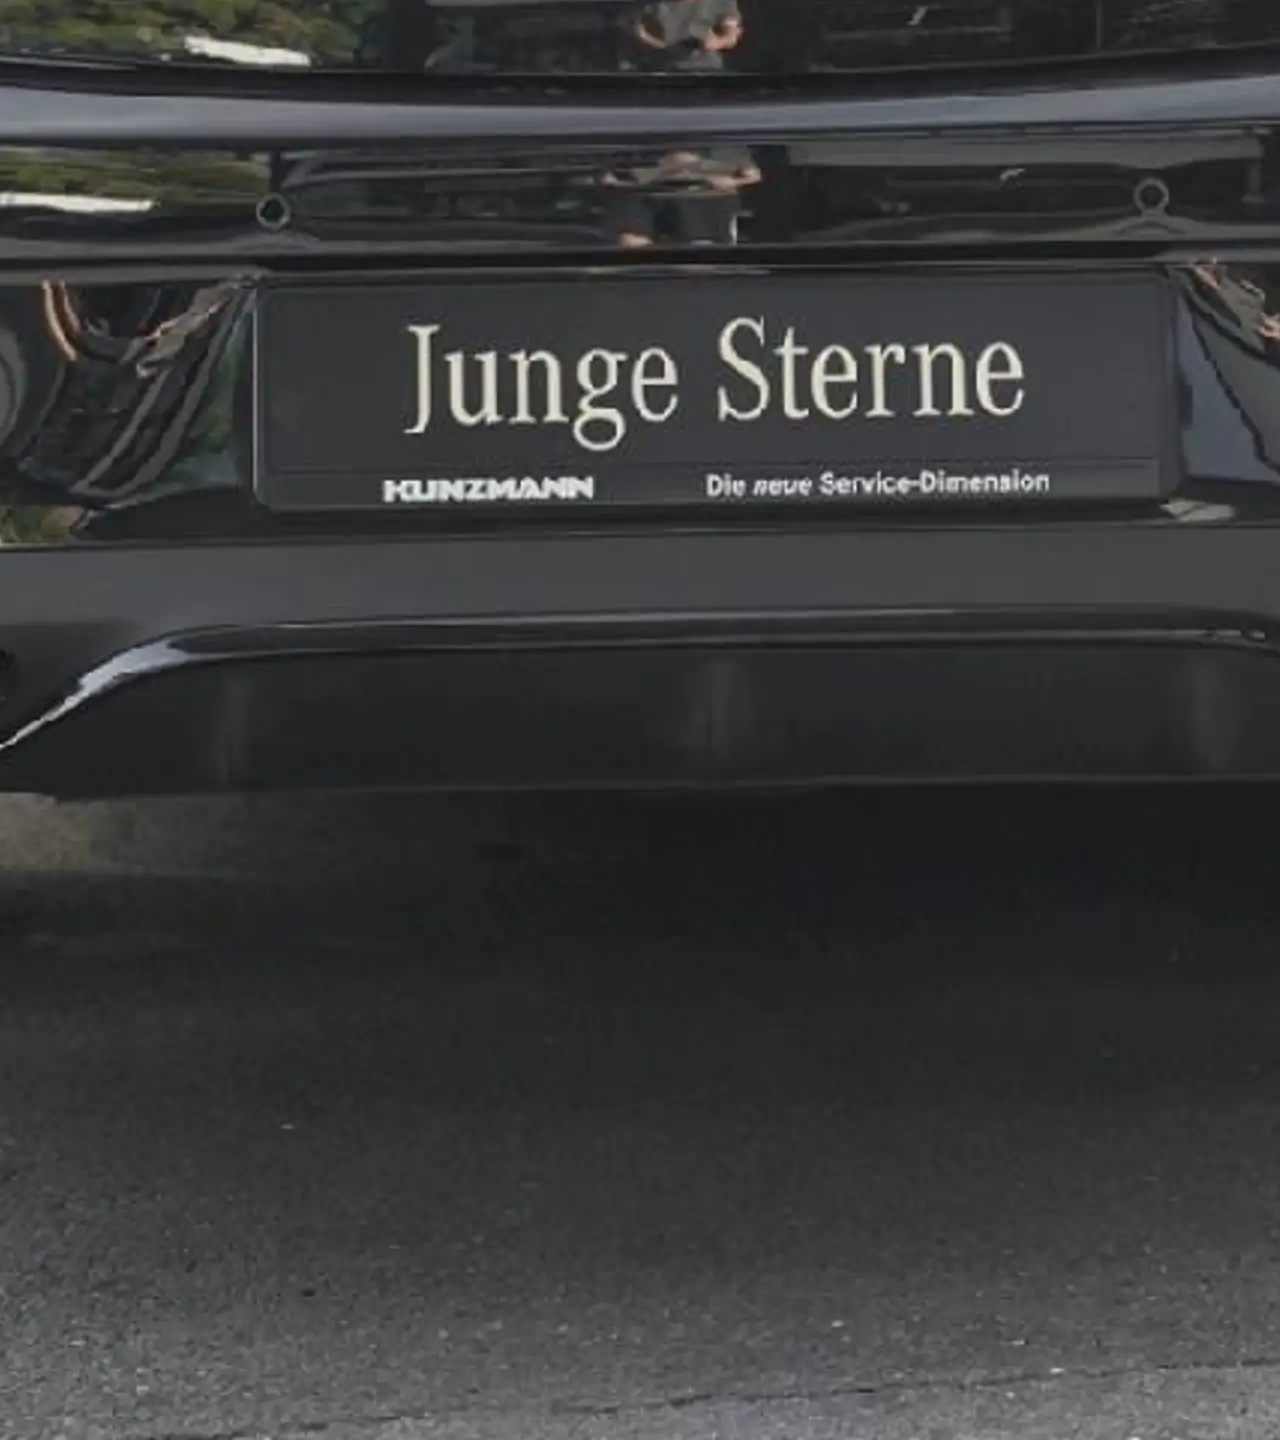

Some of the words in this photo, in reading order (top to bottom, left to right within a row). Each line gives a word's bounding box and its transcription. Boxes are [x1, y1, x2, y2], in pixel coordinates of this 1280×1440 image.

[404, 324, 679, 451] Junge
[717, 316, 1024, 421] Sterne
[382, 476, 595, 503] KUNZMANN
[705, 472, 747, 497] Die
[752, 476, 813, 497] neue
[819, 468, 1051, 496] Service-Dimension
